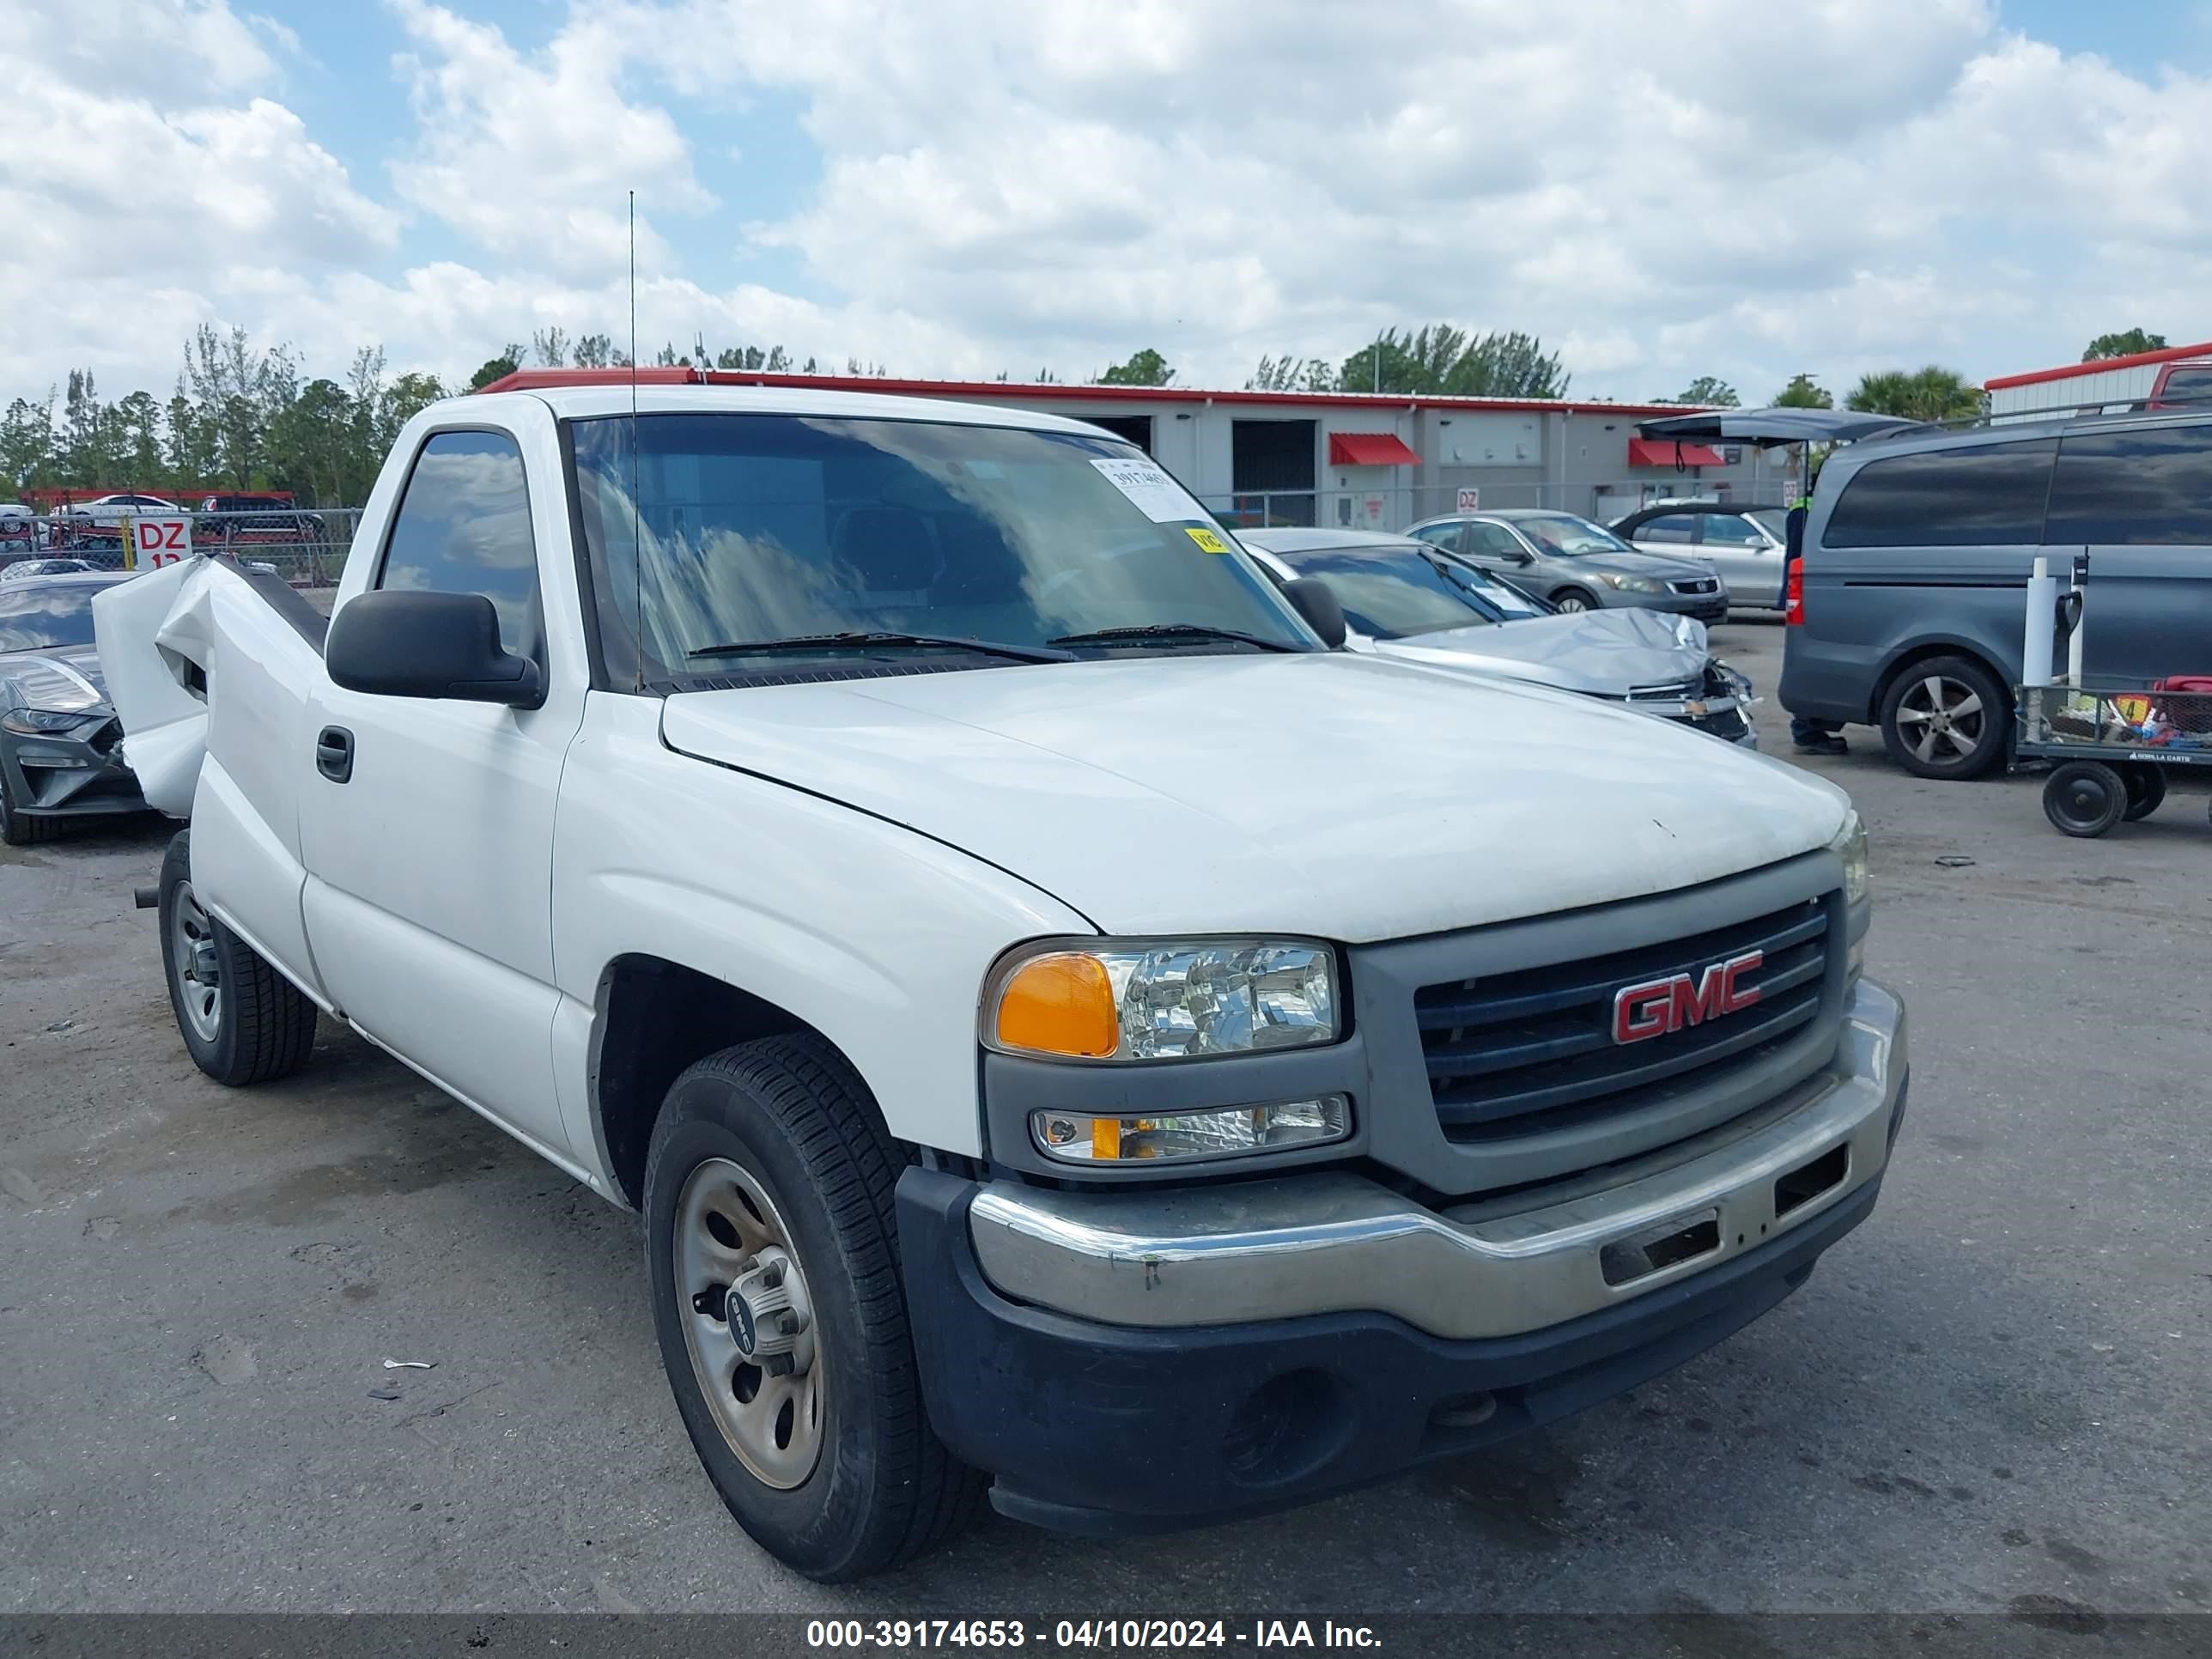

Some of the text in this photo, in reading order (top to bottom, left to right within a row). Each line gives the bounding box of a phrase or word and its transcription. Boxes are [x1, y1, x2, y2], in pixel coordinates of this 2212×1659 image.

[1460, 491, 1476, 508] DZ
[139, 522, 186, 550] DZ
[1192, 533, 1221, 548] VIC
[2126, 700, 2136, 720] 4
[1612, 949, 1764, 1045] GMC
[731, 1297, 752, 1352] GMC
